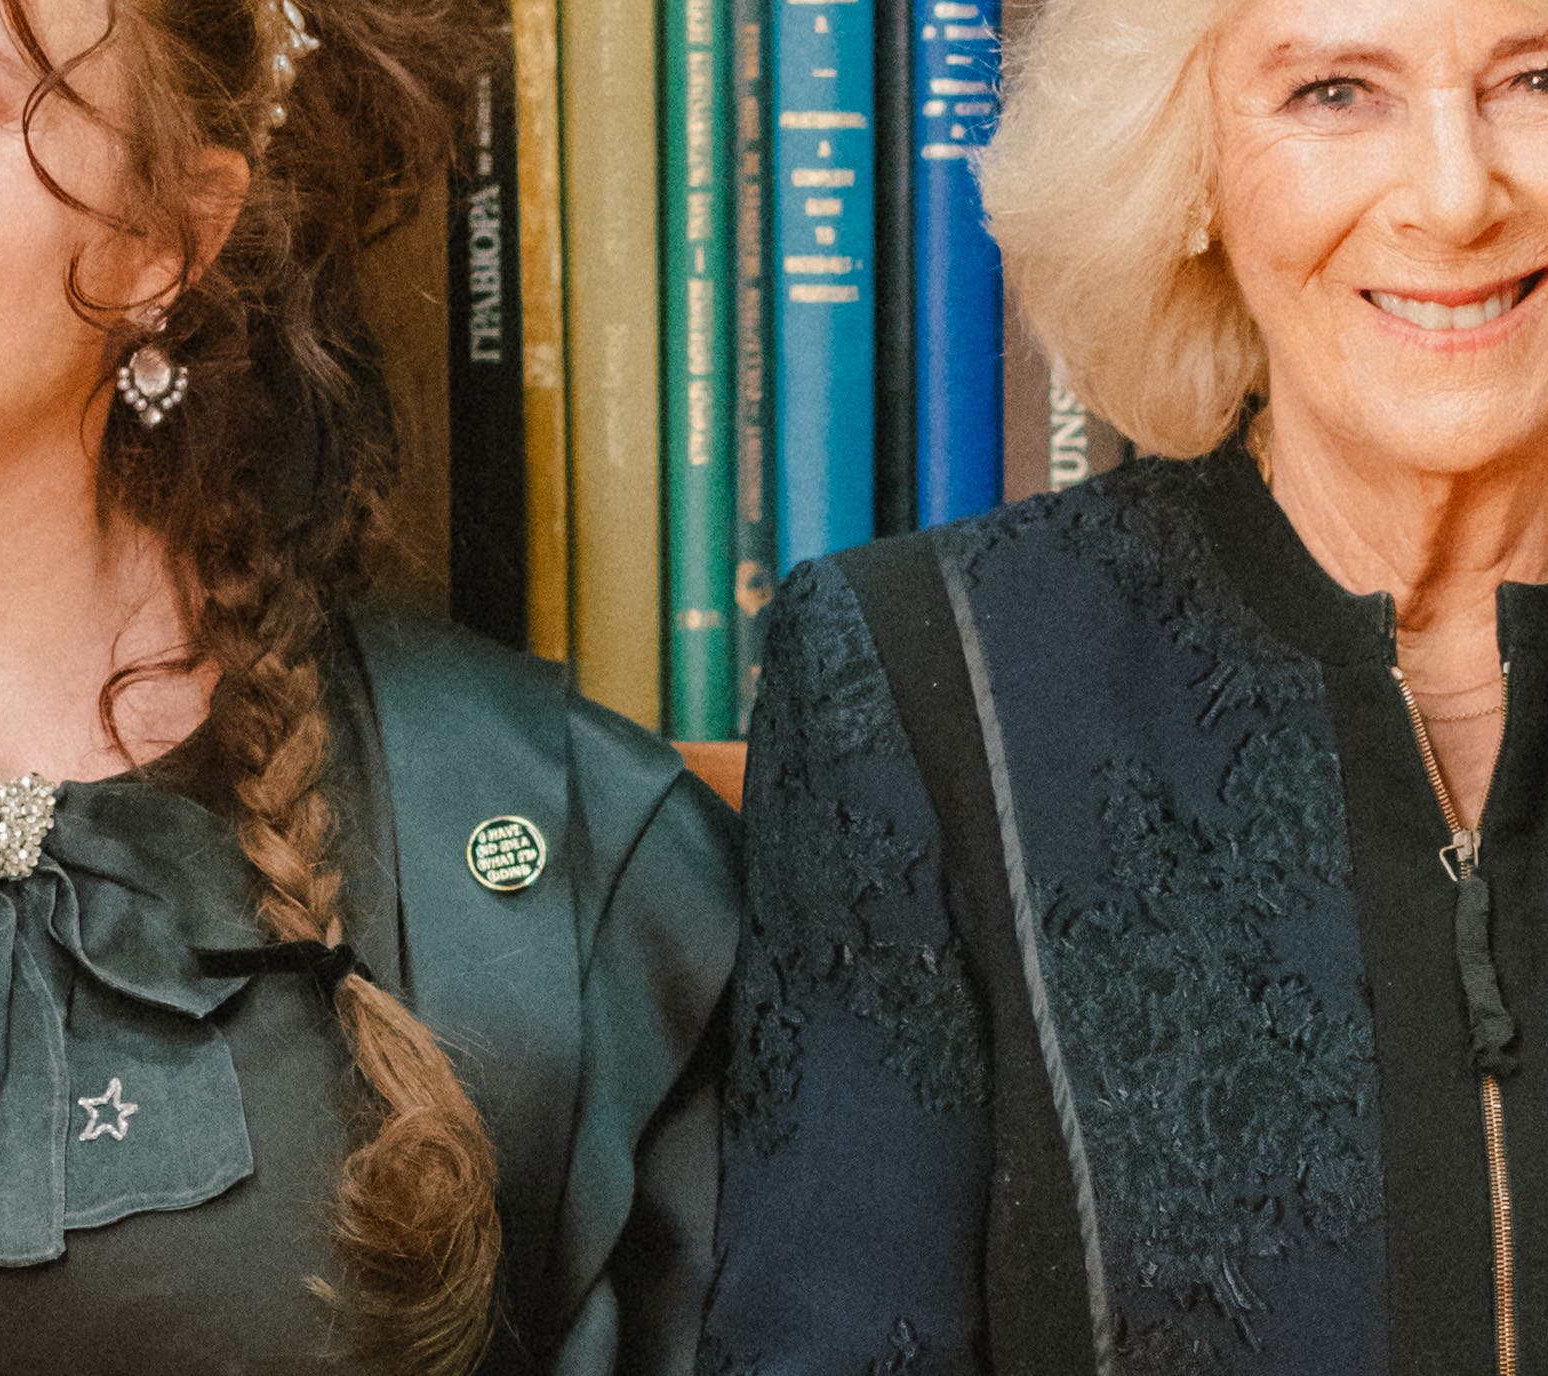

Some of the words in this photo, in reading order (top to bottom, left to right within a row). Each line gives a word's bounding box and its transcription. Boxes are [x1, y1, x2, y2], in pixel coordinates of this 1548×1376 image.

[488, 824, 522, 841] HAVE
[499, 836, 531, 853] IDEA
[476, 853, 515, 871] WHAT
[487, 864, 532, 882] DOING
